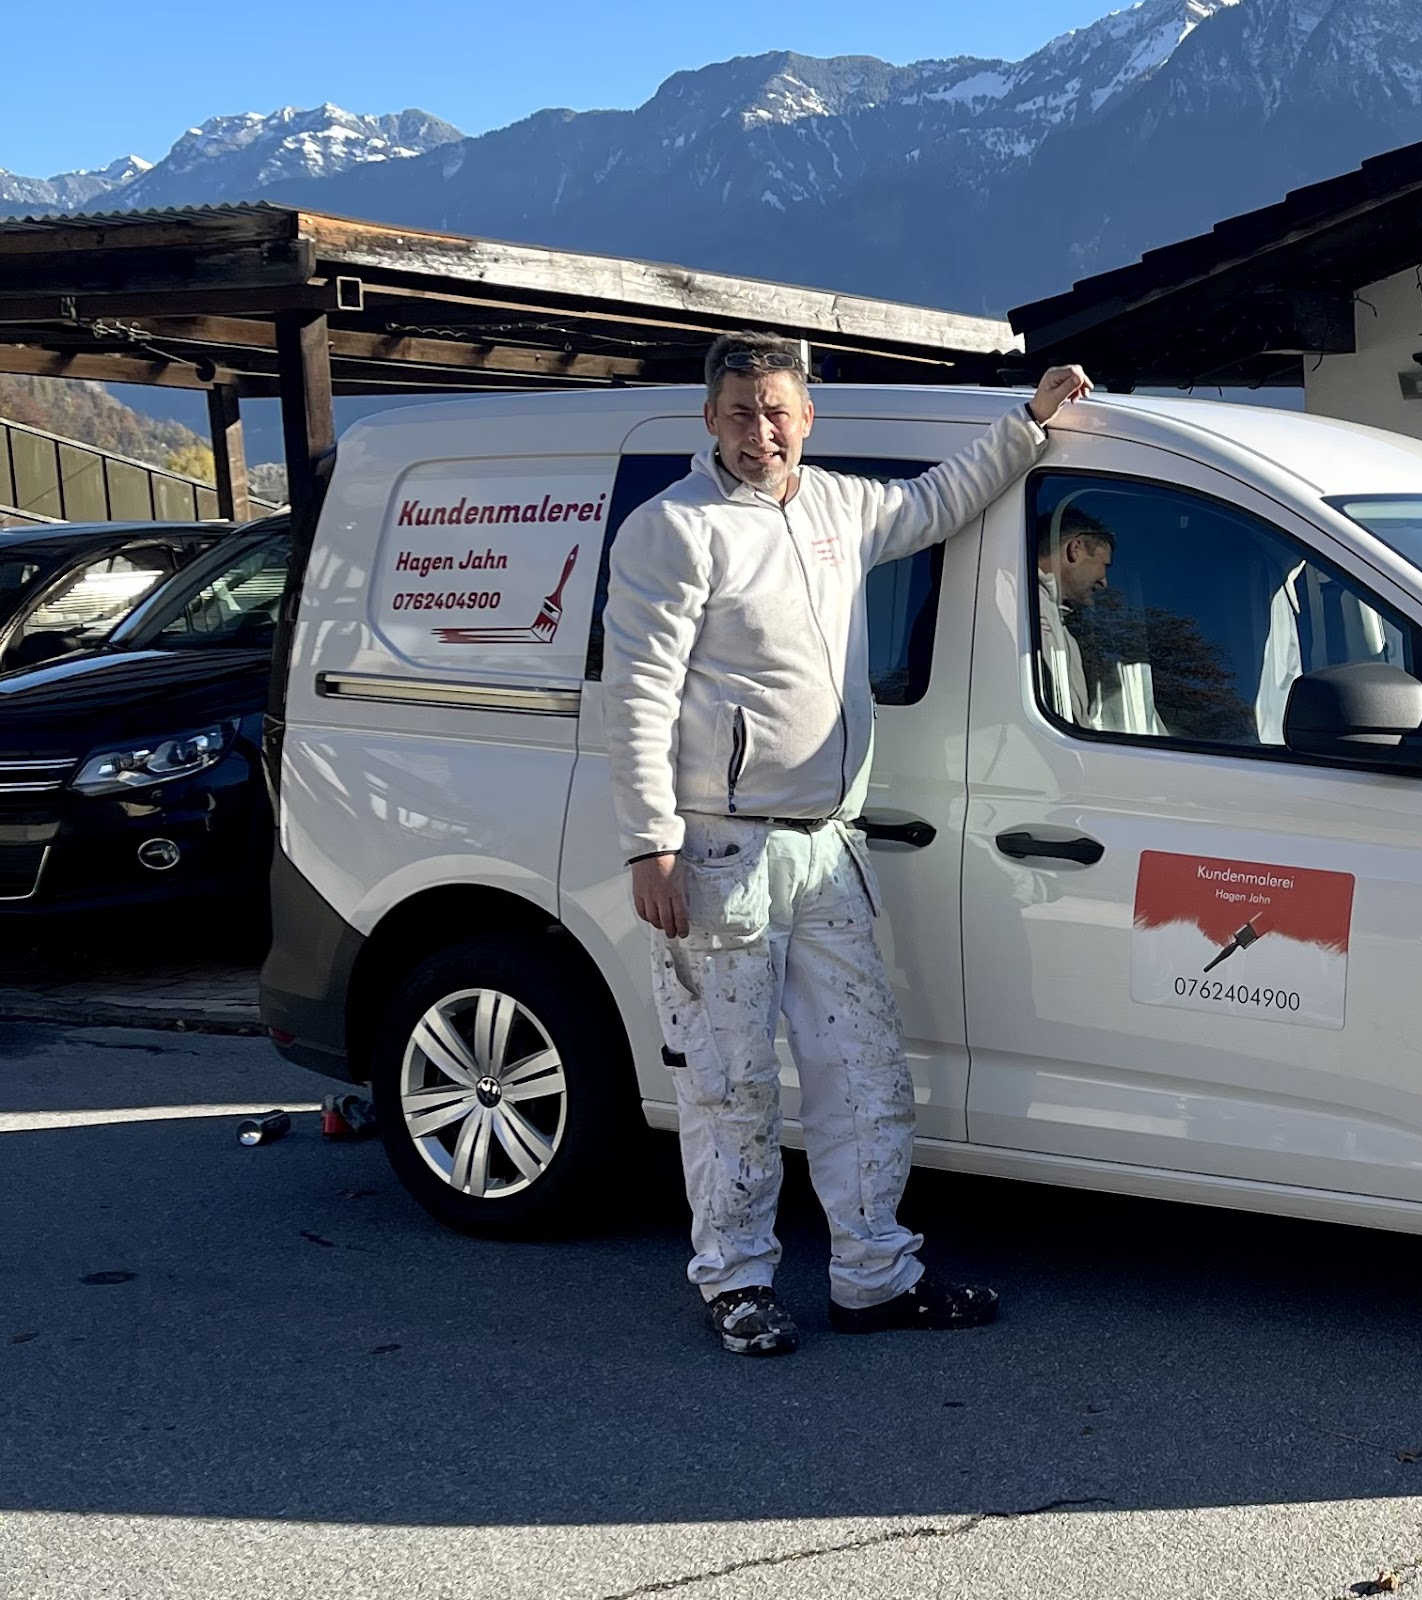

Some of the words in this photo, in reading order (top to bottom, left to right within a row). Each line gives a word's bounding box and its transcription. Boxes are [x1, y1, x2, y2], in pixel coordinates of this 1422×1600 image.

[397, 493, 606, 526] Kundenmalerei
[395, 551, 454, 577] Hagen
[458, 548, 508, 570] Jahn
[392, 592, 501, 610] 0762404900
[1196, 864, 1295, 889] Kundenmalerei
[1215, 889, 1246, 902] Hagen
[1249, 893, 1271, 905] Jahn
[1174, 977, 1300, 1011] 0762404900
